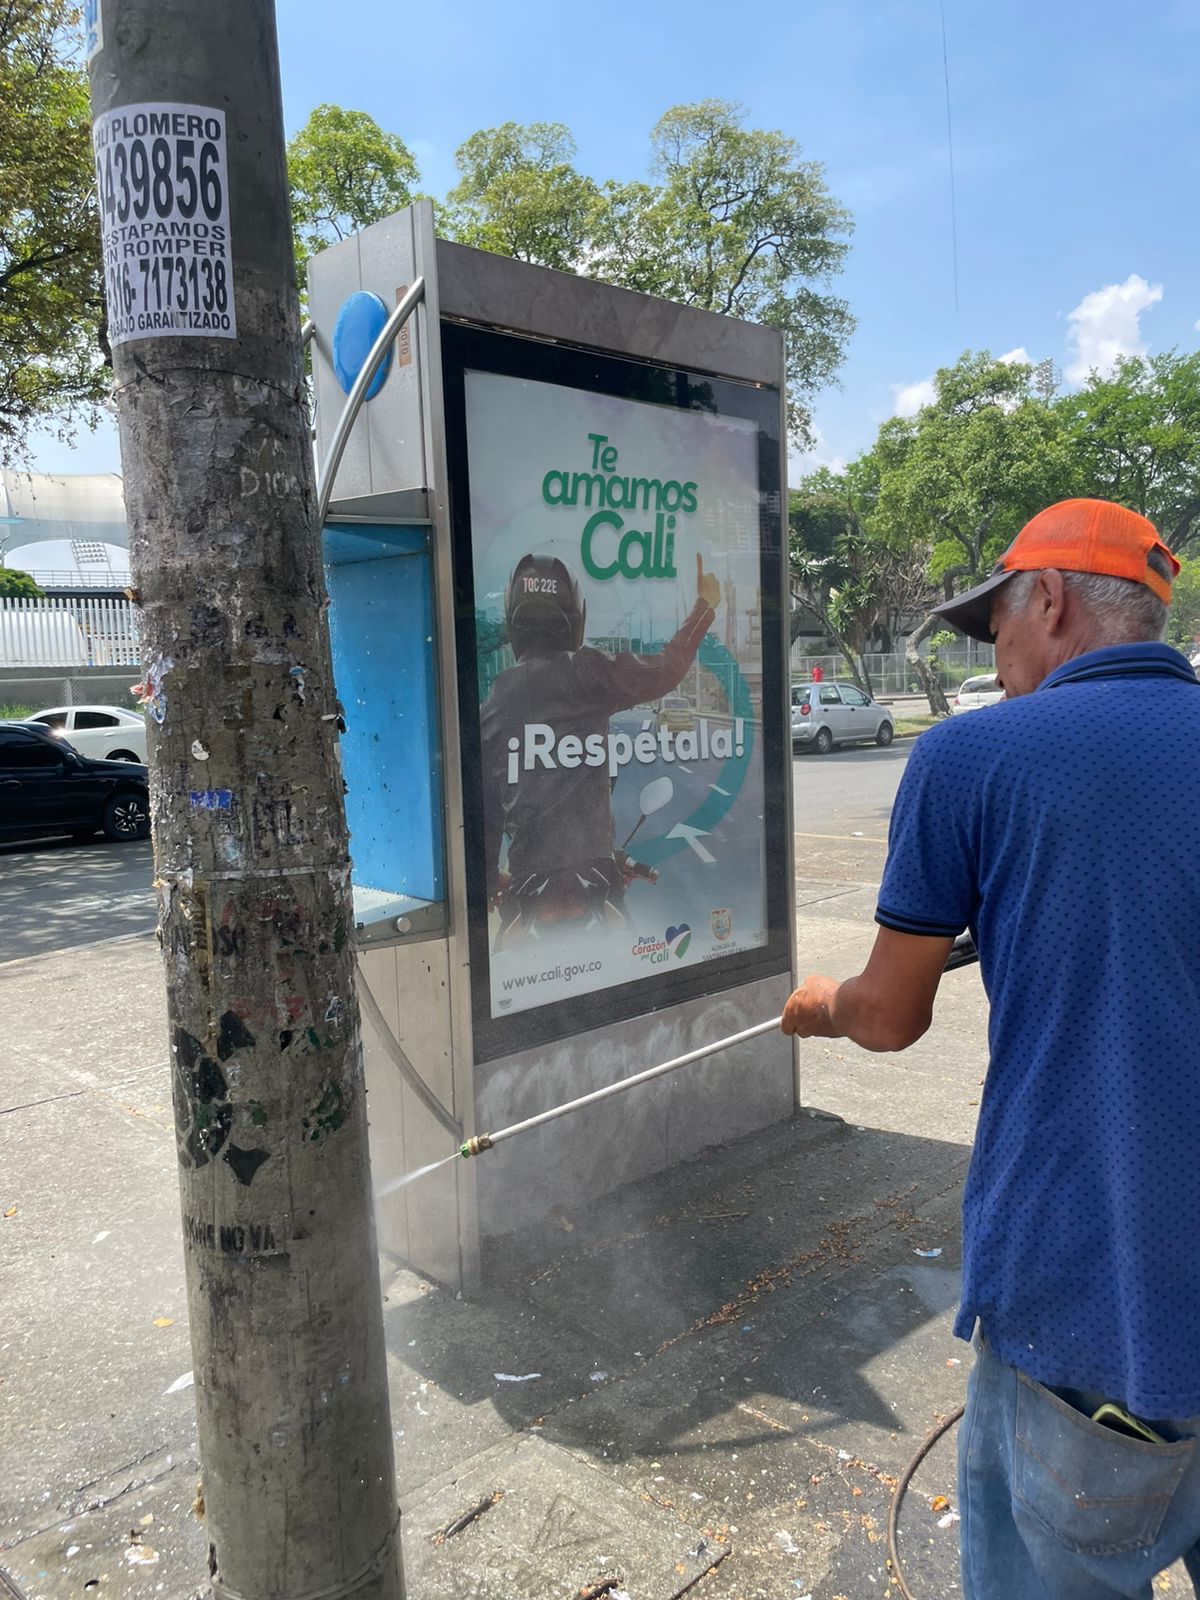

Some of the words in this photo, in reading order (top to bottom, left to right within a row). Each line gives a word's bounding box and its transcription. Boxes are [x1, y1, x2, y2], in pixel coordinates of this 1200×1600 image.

[112, 112, 222, 144] PLOMERO
[104, 222, 226, 248] ESTAPAMOS
[105, 247, 118, 267] IN
[123, 238, 226, 259] ROMPER
[587, 432, 618, 473] Te
[541, 469, 698, 513] amamos
[580, 510, 677, 580] Cali
[507, 716, 745, 784] ¡Respétala!
[638, 935, 656, 946] Puro
[650, 951, 669, 964] Cali
[502, 959, 602, 991] www.cali.gov.co
